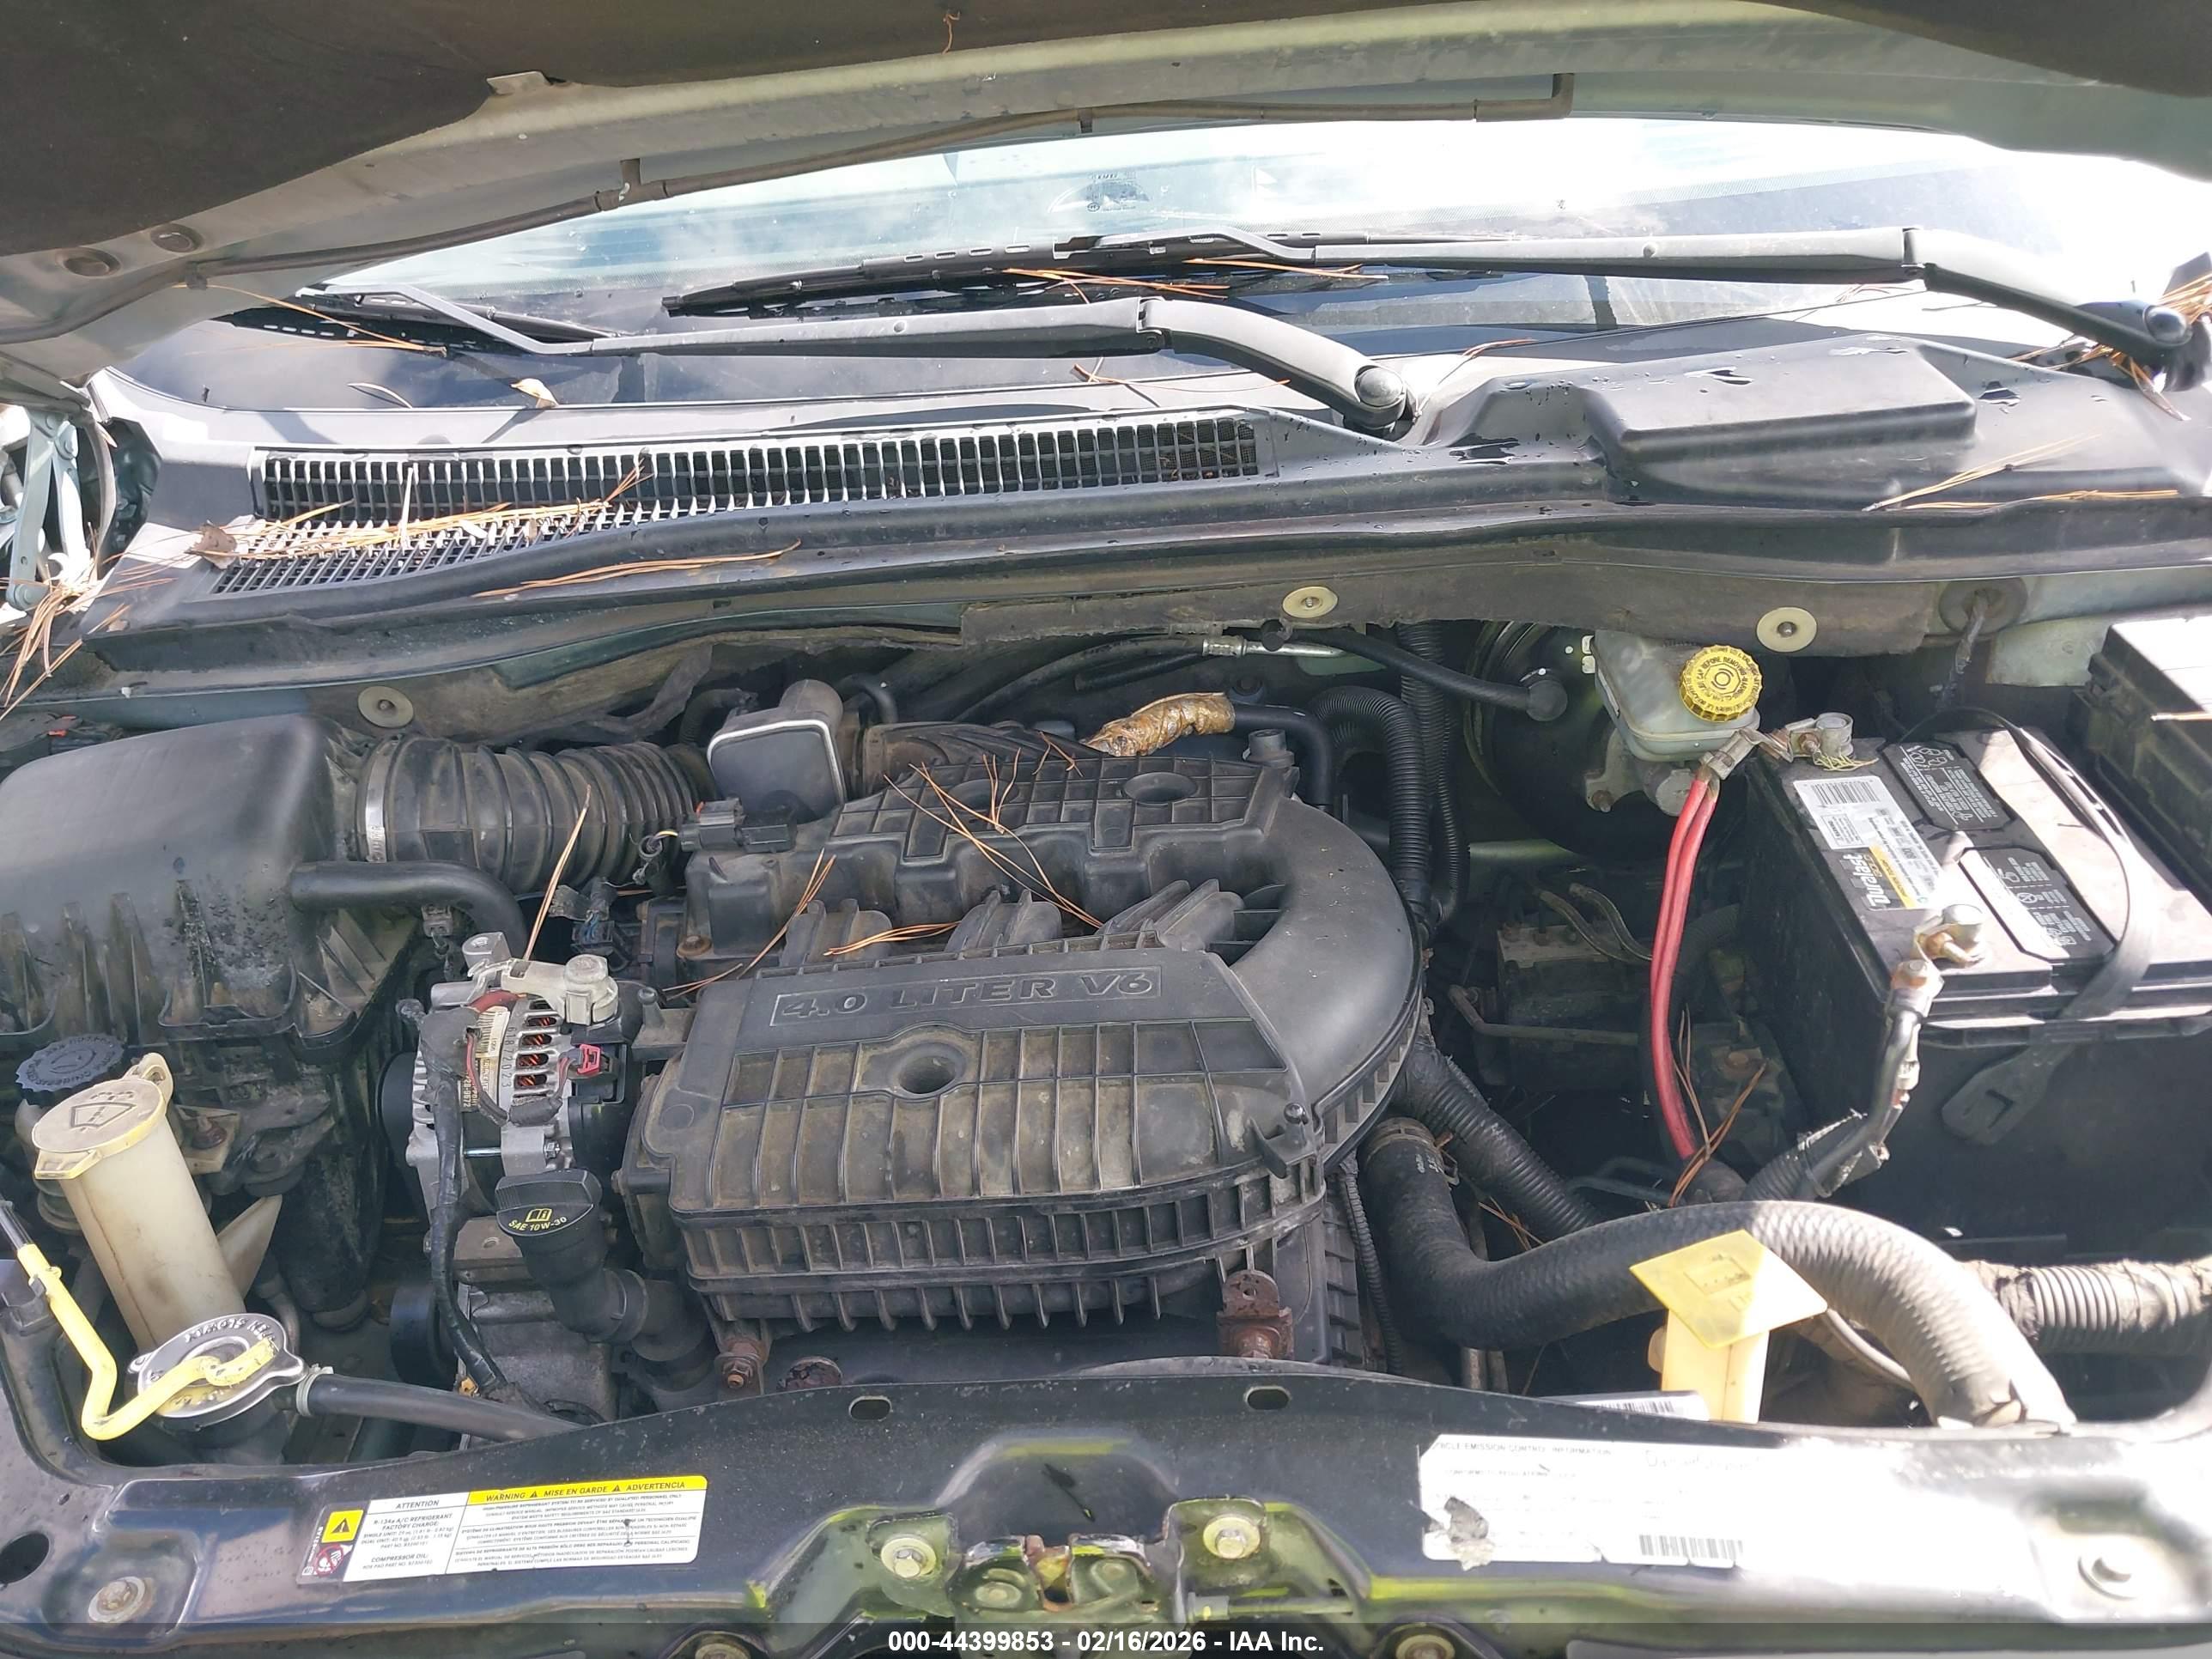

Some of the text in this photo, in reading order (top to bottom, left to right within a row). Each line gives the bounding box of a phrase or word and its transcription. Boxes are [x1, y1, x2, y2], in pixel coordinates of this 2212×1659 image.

[1843, 854, 1891, 907] Duralast
[782, 971, 1152, 1018] 4.0 LITER V6
[508, 1216, 568, 1231] SAE 10W-30
[484, 1492, 526, 1501] WARNING
[579, 1486, 608, 1495] GARDE
[625, 1480, 685, 1492] ADVERTENCIA
[395, 1499, 439, 1509] ATTENTION
[410, 1513, 453, 1522] REFRIGERANT
